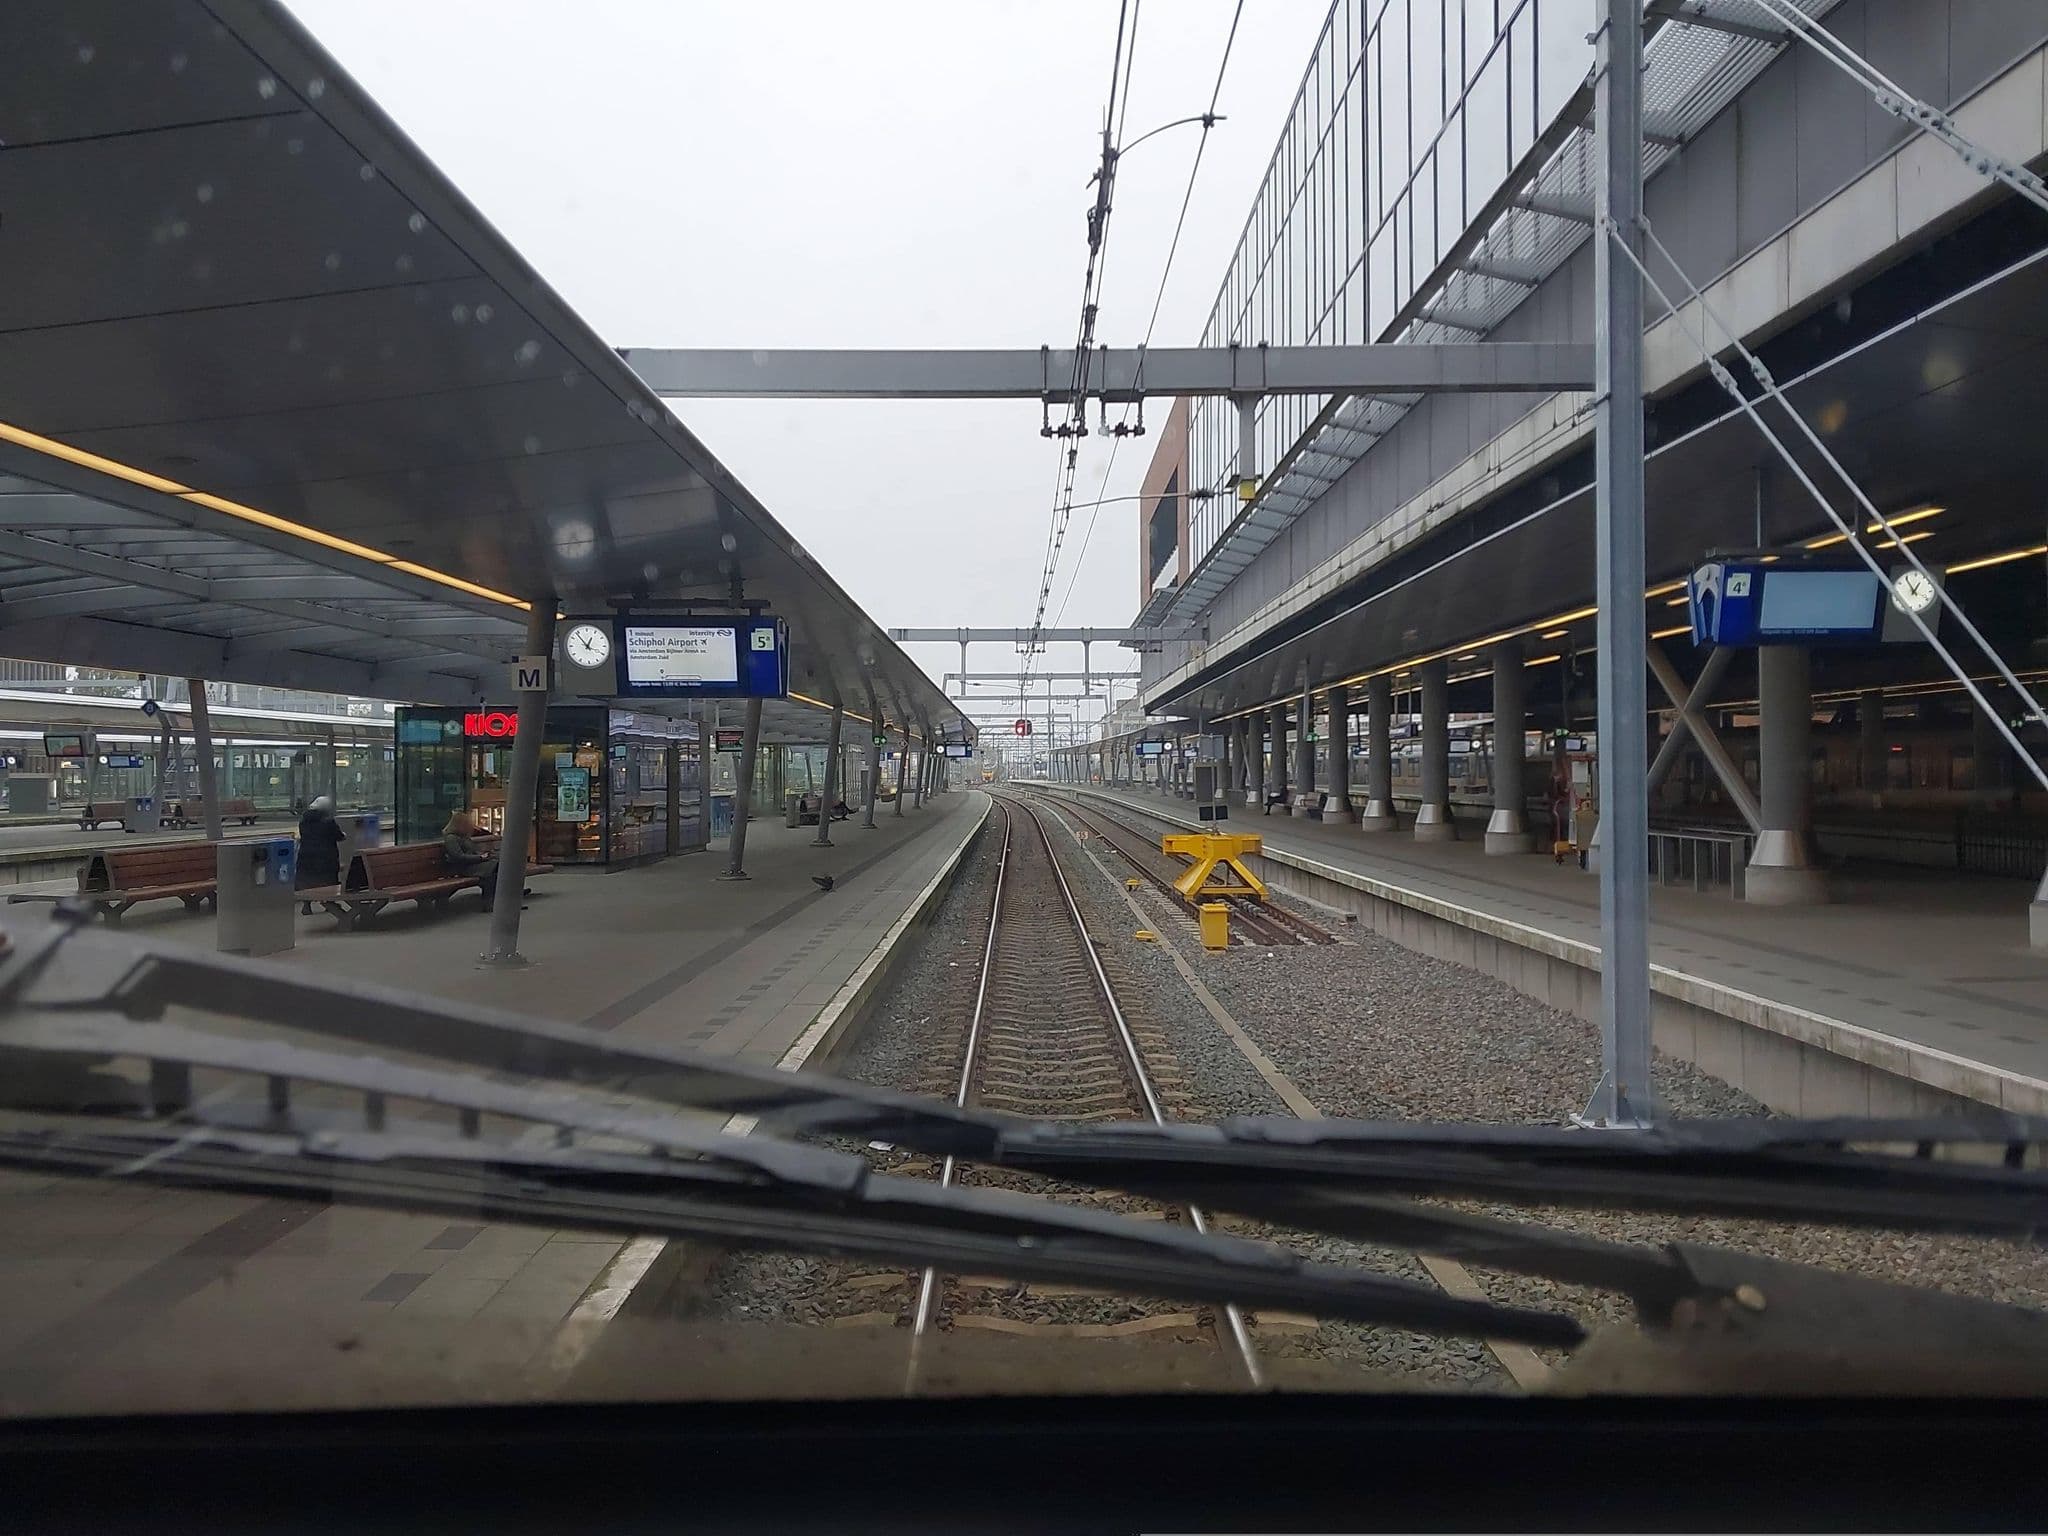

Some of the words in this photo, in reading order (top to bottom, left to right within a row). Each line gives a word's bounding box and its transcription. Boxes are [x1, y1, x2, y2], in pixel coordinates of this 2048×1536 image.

[629, 638, 665, 647] Schiphol
[668, 638, 698, 647] Airport
[519, 669, 540, 687] M
